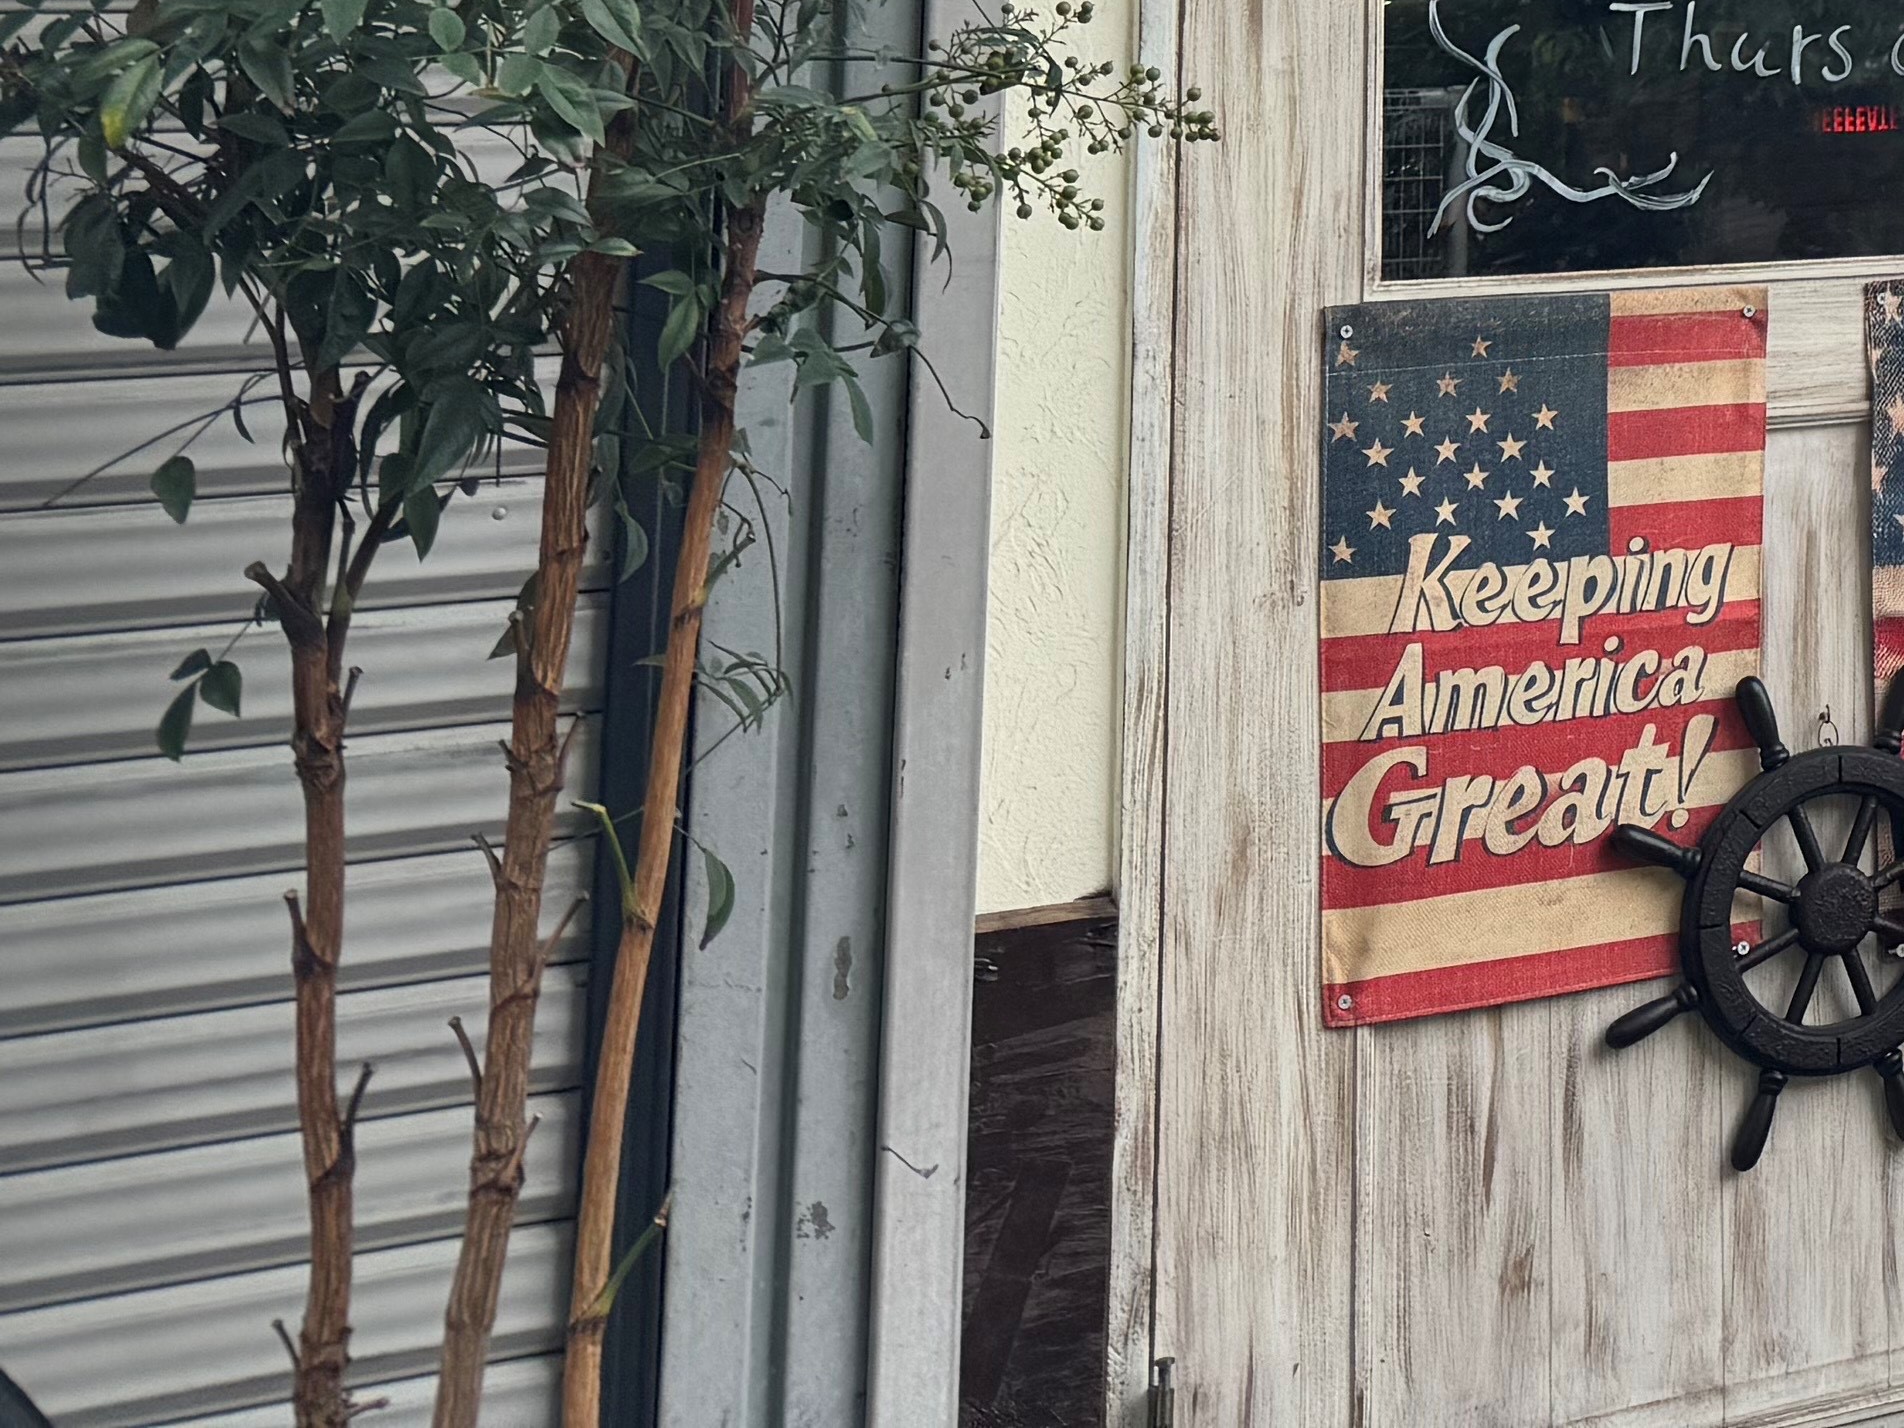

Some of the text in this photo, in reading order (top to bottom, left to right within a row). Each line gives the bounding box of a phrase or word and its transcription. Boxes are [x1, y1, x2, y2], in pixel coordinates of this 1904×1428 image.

[1390, 531, 1733, 647] Keeping
[1359, 635, 1708, 743] America
[1326, 713, 1720, 868] Great!
